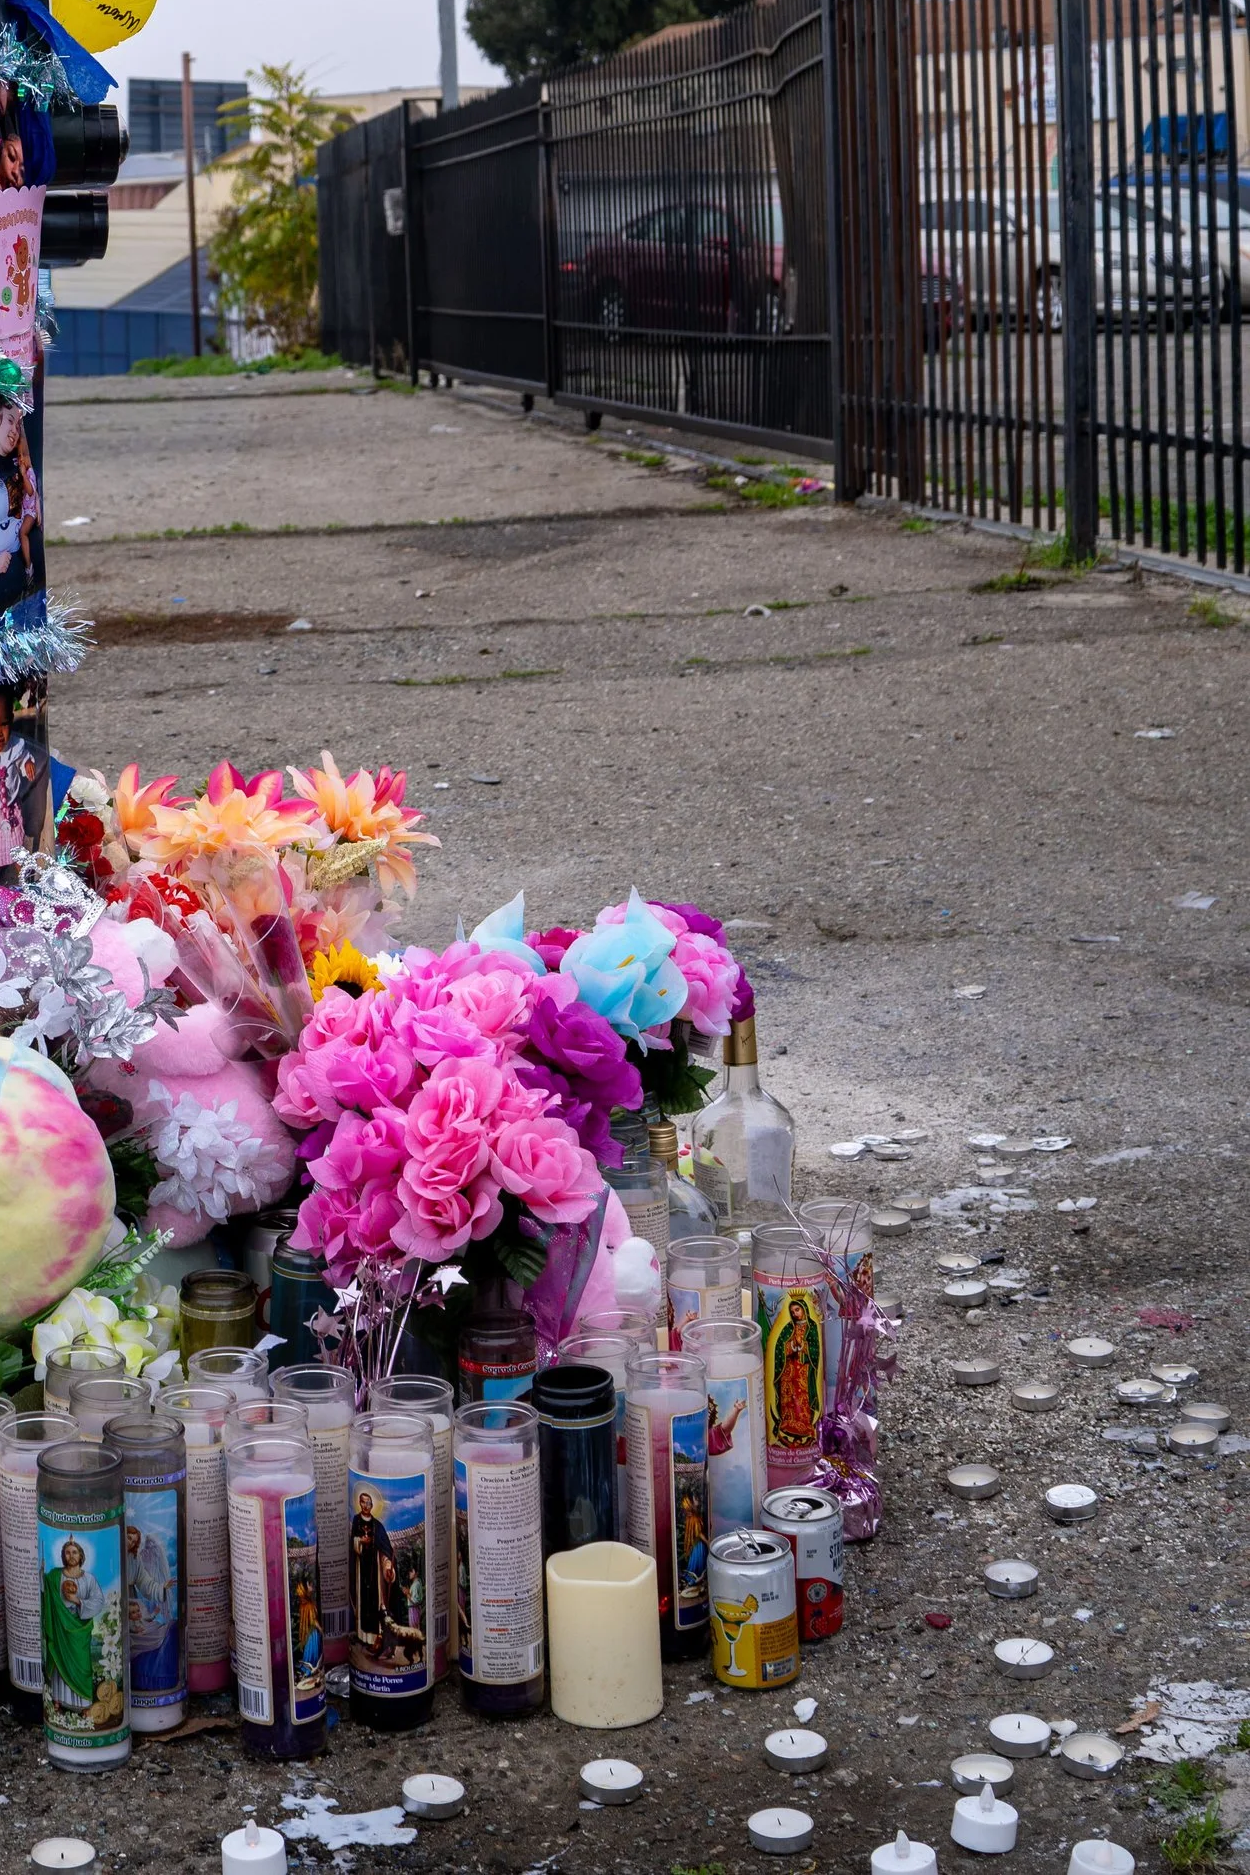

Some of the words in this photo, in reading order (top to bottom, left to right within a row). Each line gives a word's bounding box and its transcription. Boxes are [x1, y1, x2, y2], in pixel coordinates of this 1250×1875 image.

[132, 1476, 164, 1485] Guarda
[382, 1676, 404, 1684] Porres
[368, 1682, 391, 1693] Martin
